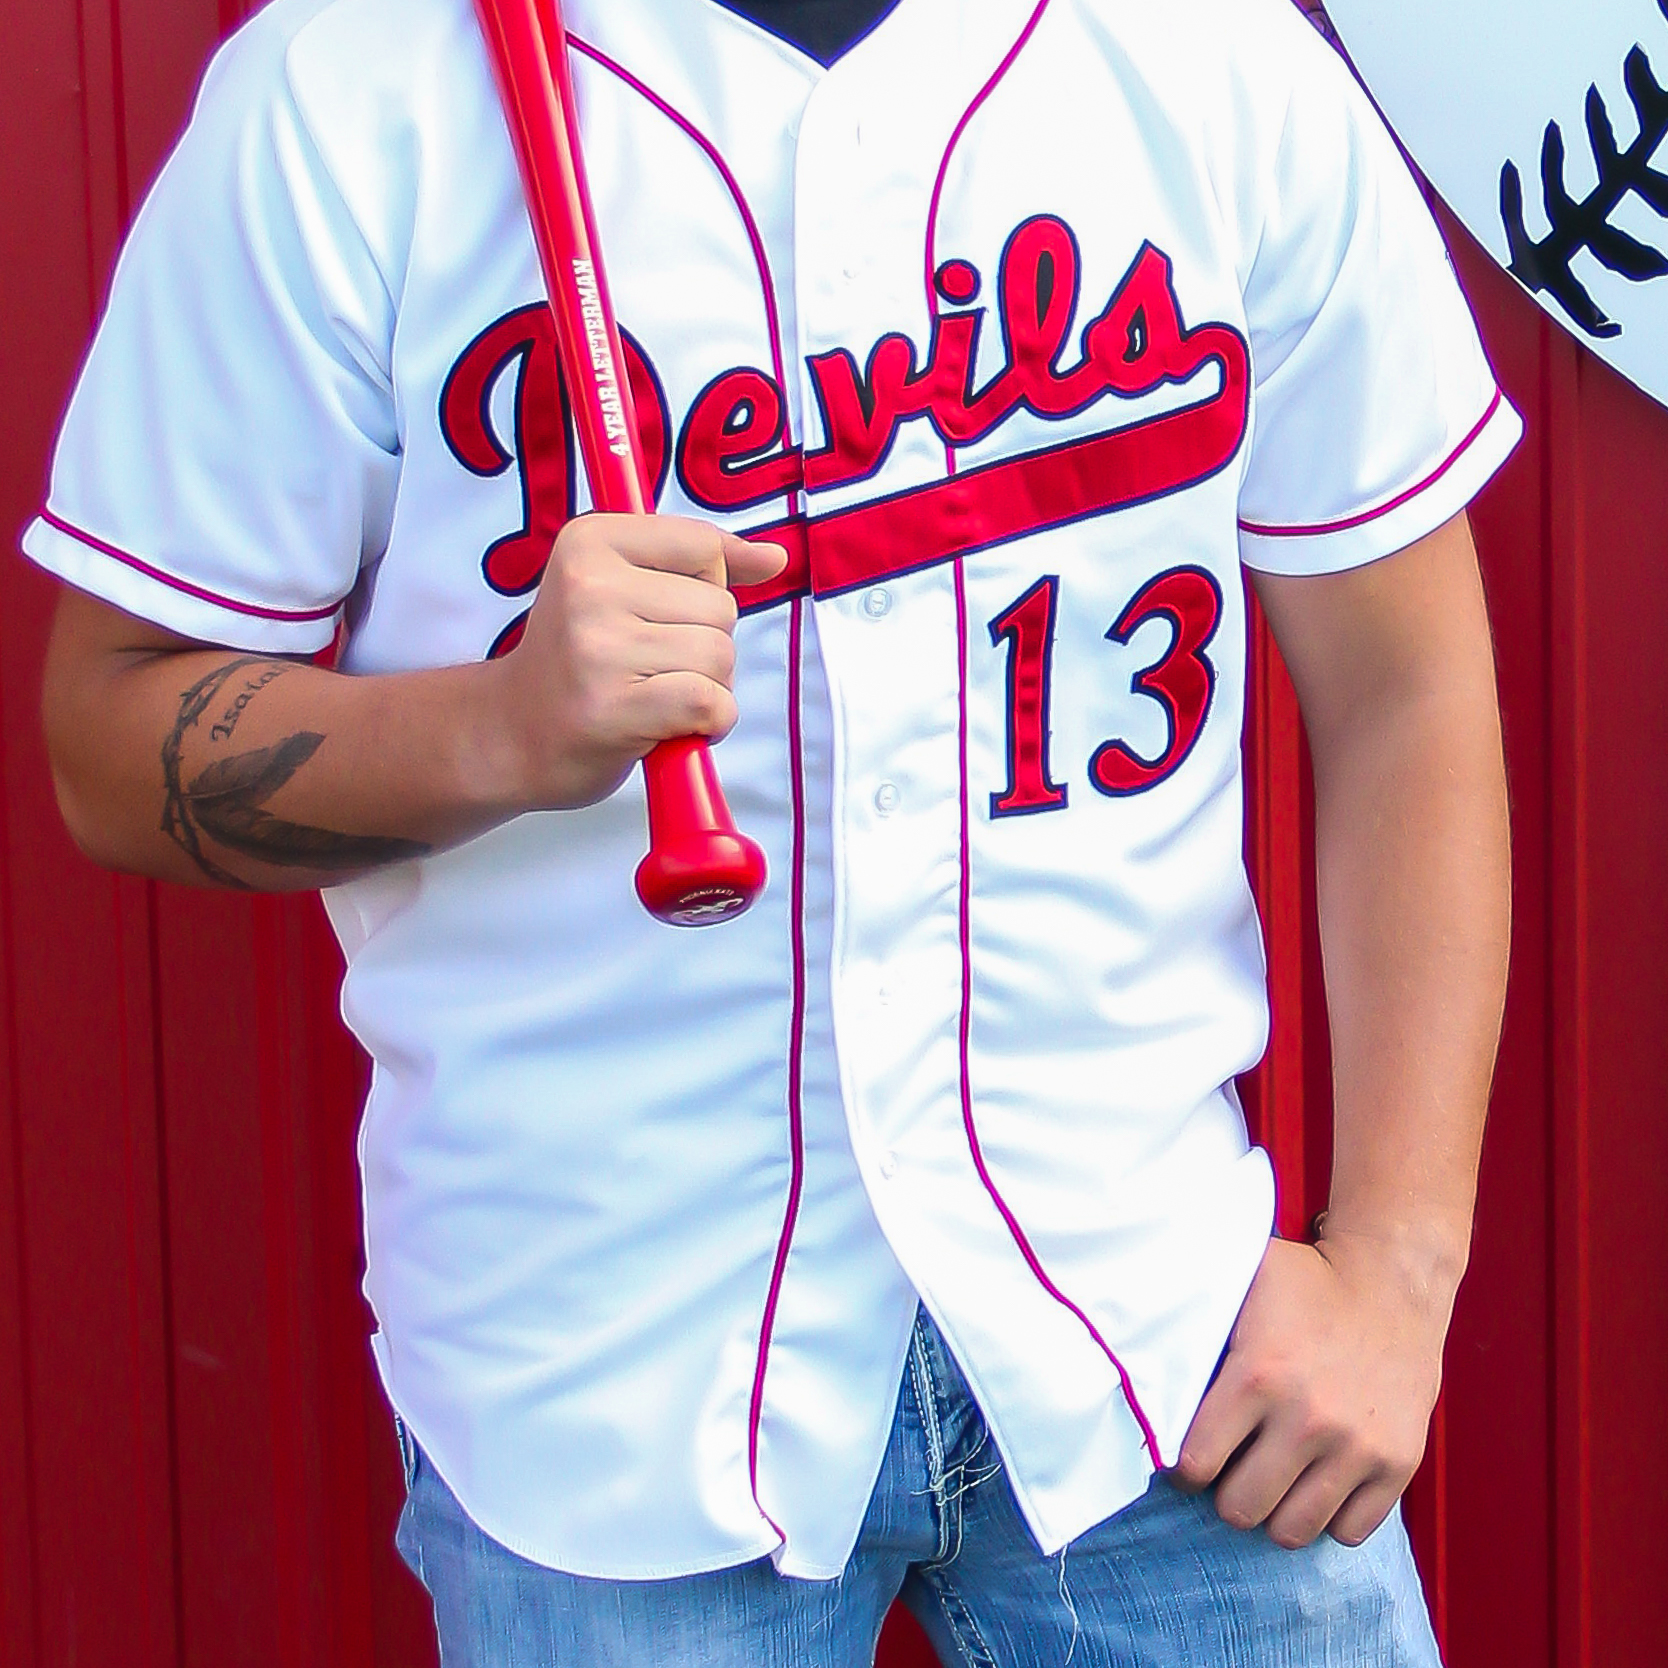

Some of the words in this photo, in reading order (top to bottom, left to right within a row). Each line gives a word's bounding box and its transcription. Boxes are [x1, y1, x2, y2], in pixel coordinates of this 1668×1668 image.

[572, 257, 616, 382] LETTERMAN
[440, 212, 1252, 598] Devils
[598, 385, 627, 440] YEAR
[609, 442, 629, 457] 4
[989, 565, 1223, 820] 13
